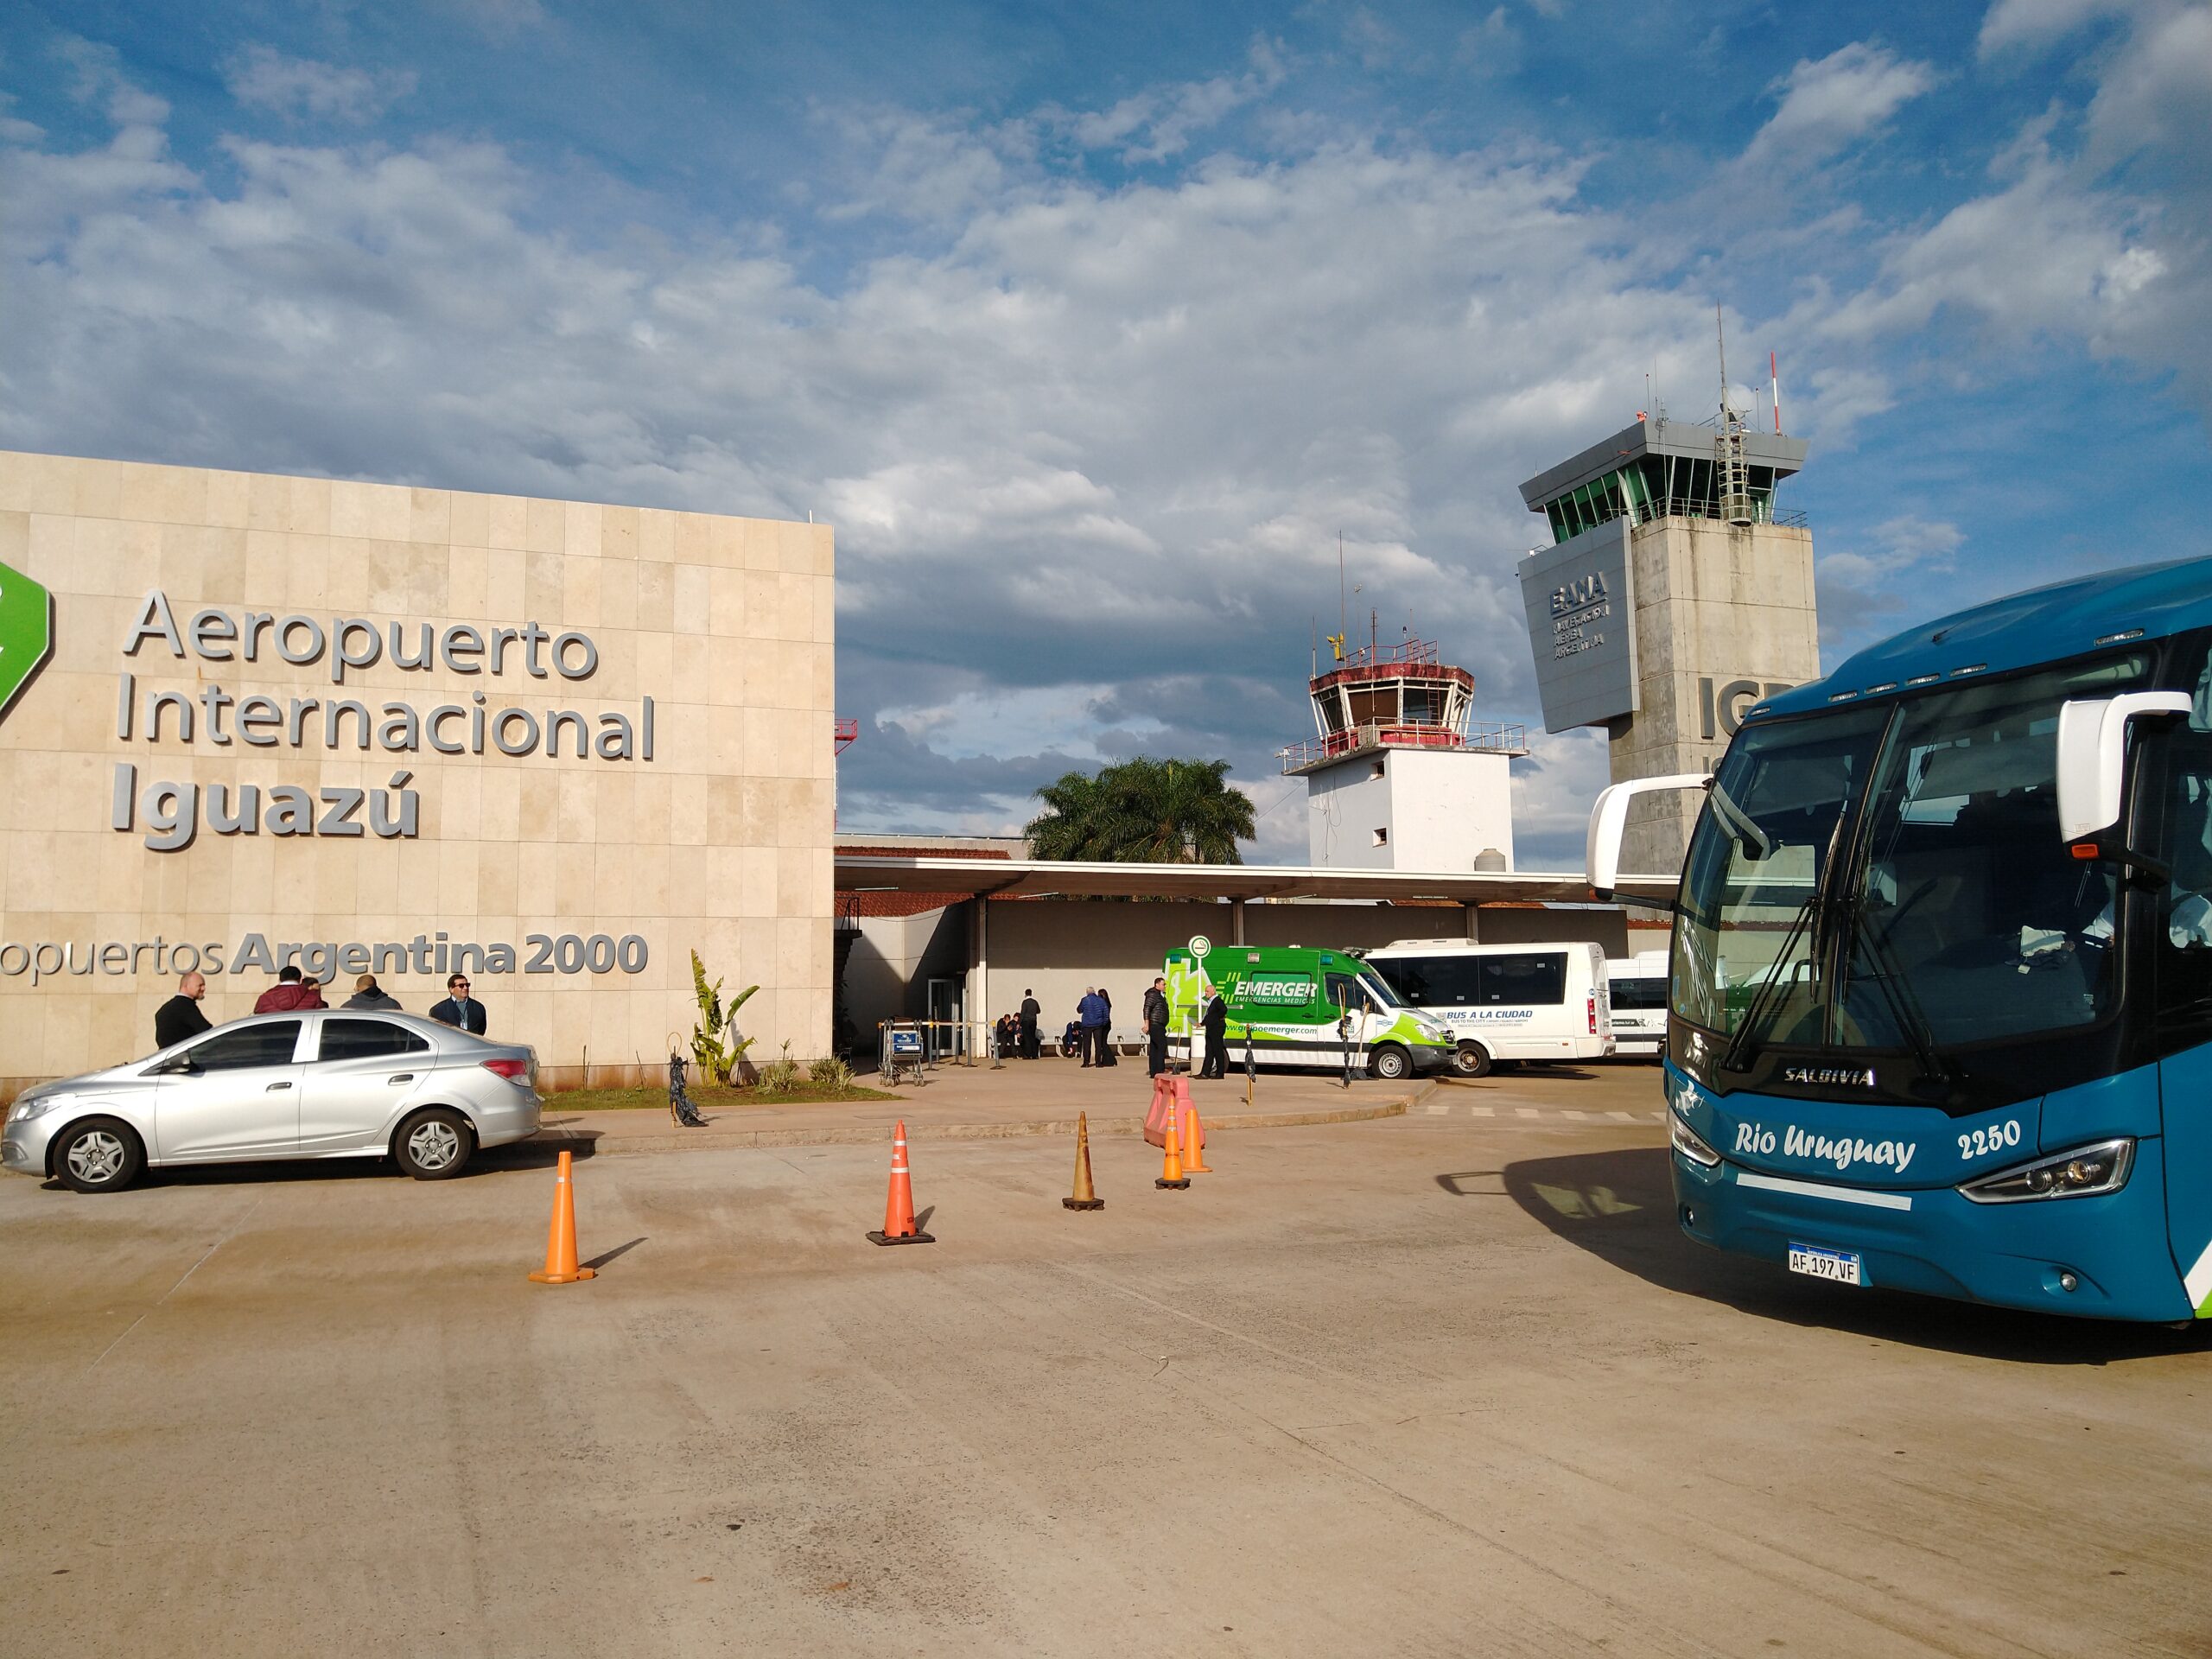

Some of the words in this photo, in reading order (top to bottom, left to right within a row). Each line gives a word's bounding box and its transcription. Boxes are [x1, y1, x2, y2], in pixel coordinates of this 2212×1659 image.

[1549, 571, 1608, 615] EANA
[123, 588, 600, 683] Aeropuerto
[118, 672, 654, 761] Internacional
[1698, 677, 1795, 740] IG
[111, 762, 420, 852] Iguazú
[229, 931, 517, 986] Argentina
[524, 933, 649, 975] 2000
[1234, 981, 1318, 997] EMERGER
[1446, 1011, 1466, 1020] BUS
[1496, 1010, 1533, 1019] CIUDAD
[1735, 1122, 1777, 1154] Rio
[1783, 1124, 1916, 1173] Uruguay
[1957, 1120, 2021, 1160] 2250
[1792, 1253, 1807, 1270] AF
[1812, 1257, 1834, 1276] 197
[1839, 1262, 1854, 1280] VF
